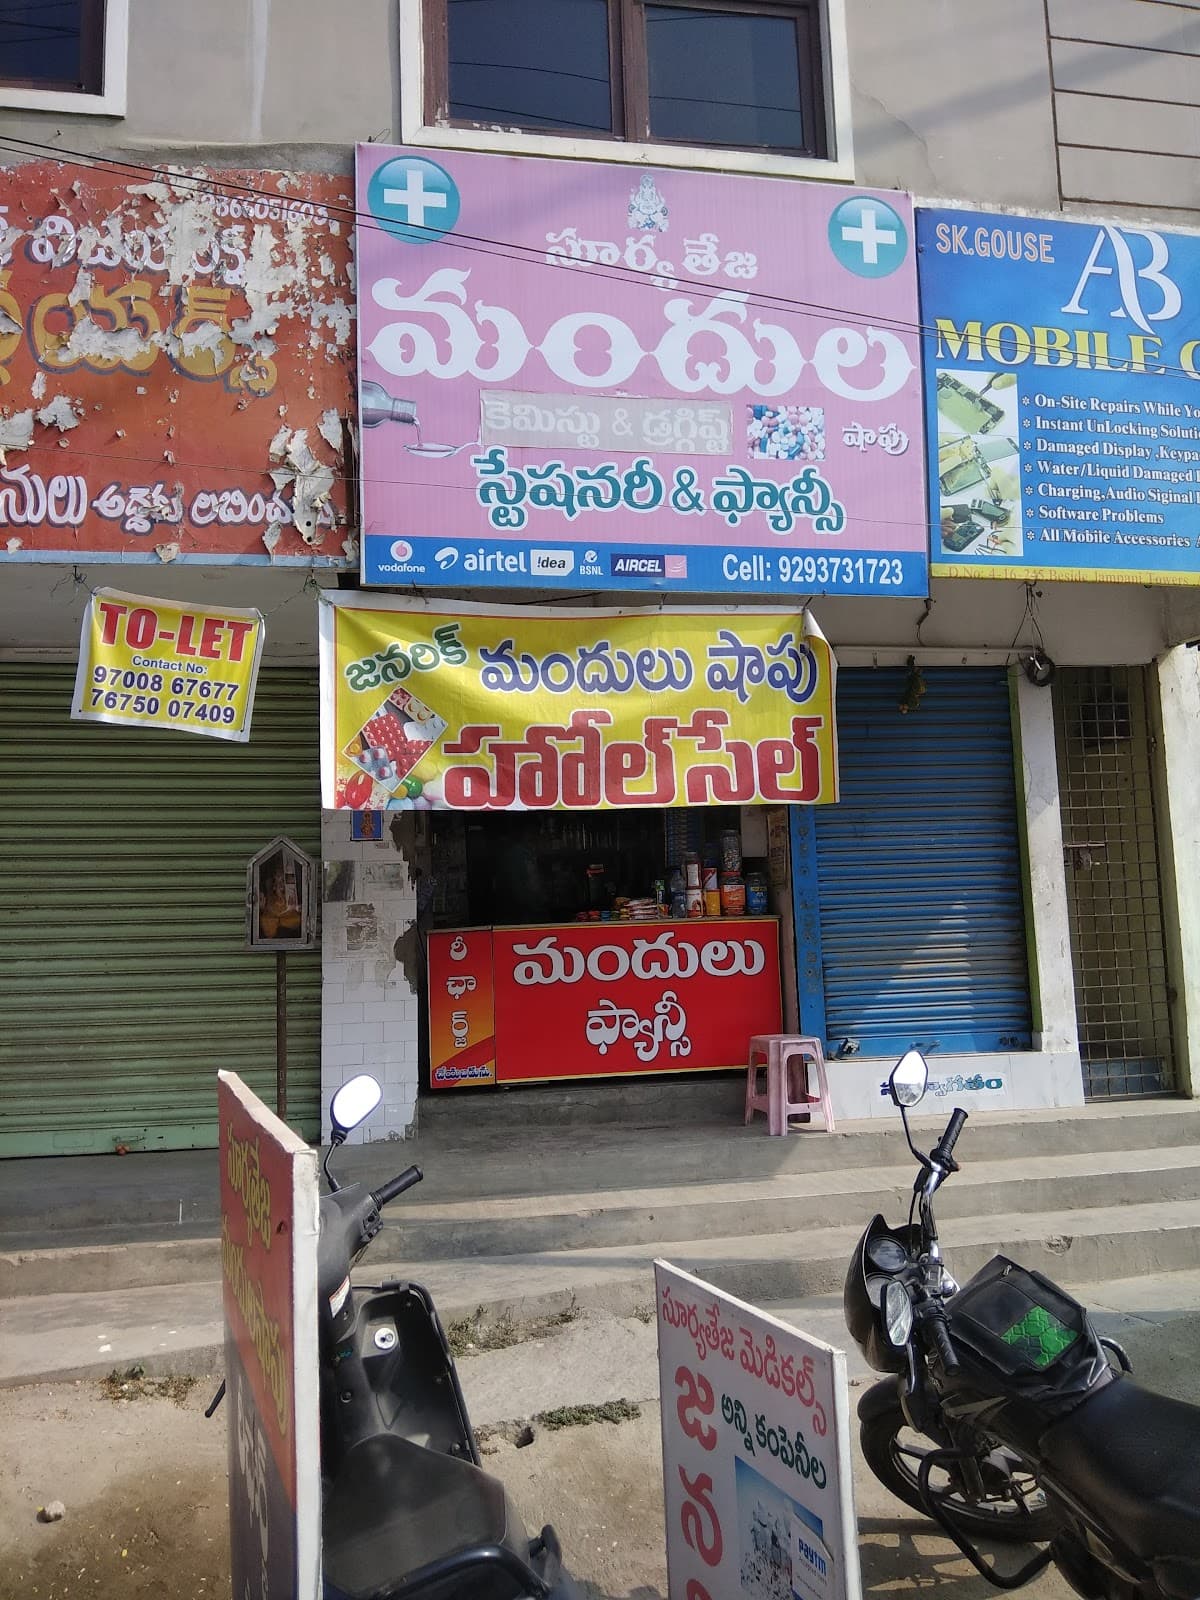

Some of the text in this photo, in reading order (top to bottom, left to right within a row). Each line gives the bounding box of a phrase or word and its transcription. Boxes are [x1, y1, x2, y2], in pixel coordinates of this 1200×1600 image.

[545, 227, 759, 291] సూర్య తేజ
[935, 223, 1055, 264] SK.GOUSE
[365, 268, 916, 402] మందుల
[935, 318, 1166, 375] MOBILE
[612, 407, 635, 437] &
[1034, 393, 1087, 410] On-Site
[1090, 398, 1141, 414] Repairs
[1143, 401, 1182, 417] While
[842, 421, 910, 457] షాపు
[1035, 416, 1200, 440] Instant UnLocking Soluti
[1036, 438, 1100, 456] Damaged
[1102, 442, 1151, 459] Display
[471, 445, 848, 536] స్టేషనరీ & ఫ్యాన్సీ
[1133, 465, 1193, 484] Damaged
[1038, 505, 1165, 524] Software Problems
[1148, 488, 1193, 505] Siginal
[1040, 528, 1059, 542] All
[1062, 528, 1110, 544] Mobile
[1113, 530, 1191, 548] Accessories
[378, 563, 426, 573] vodafone
[464, 548, 528, 573] airtel
[579, 565, 604, 576] BSNL
[614, 558, 662, 573] AIRCEL
[722, 553, 904, 585] Cell: 9293731723
[99, 602, 254, 663] TO-LET
[132, 655, 208, 675] Contact No:
[344, 622, 820, 705] జనరిక్ మందులు షాపు
[93, 666, 240, 701] 97008 67677
[91, 688, 236, 724] 76750 07409
[512, 931, 767, 985] మందులు
[585, 990, 692, 1062] ఫ్యాన్సీ
[662, 1286, 735, 1361] సూర్యతేజ
[722, 1393, 827, 1490] అన్ని కంపెనీల
